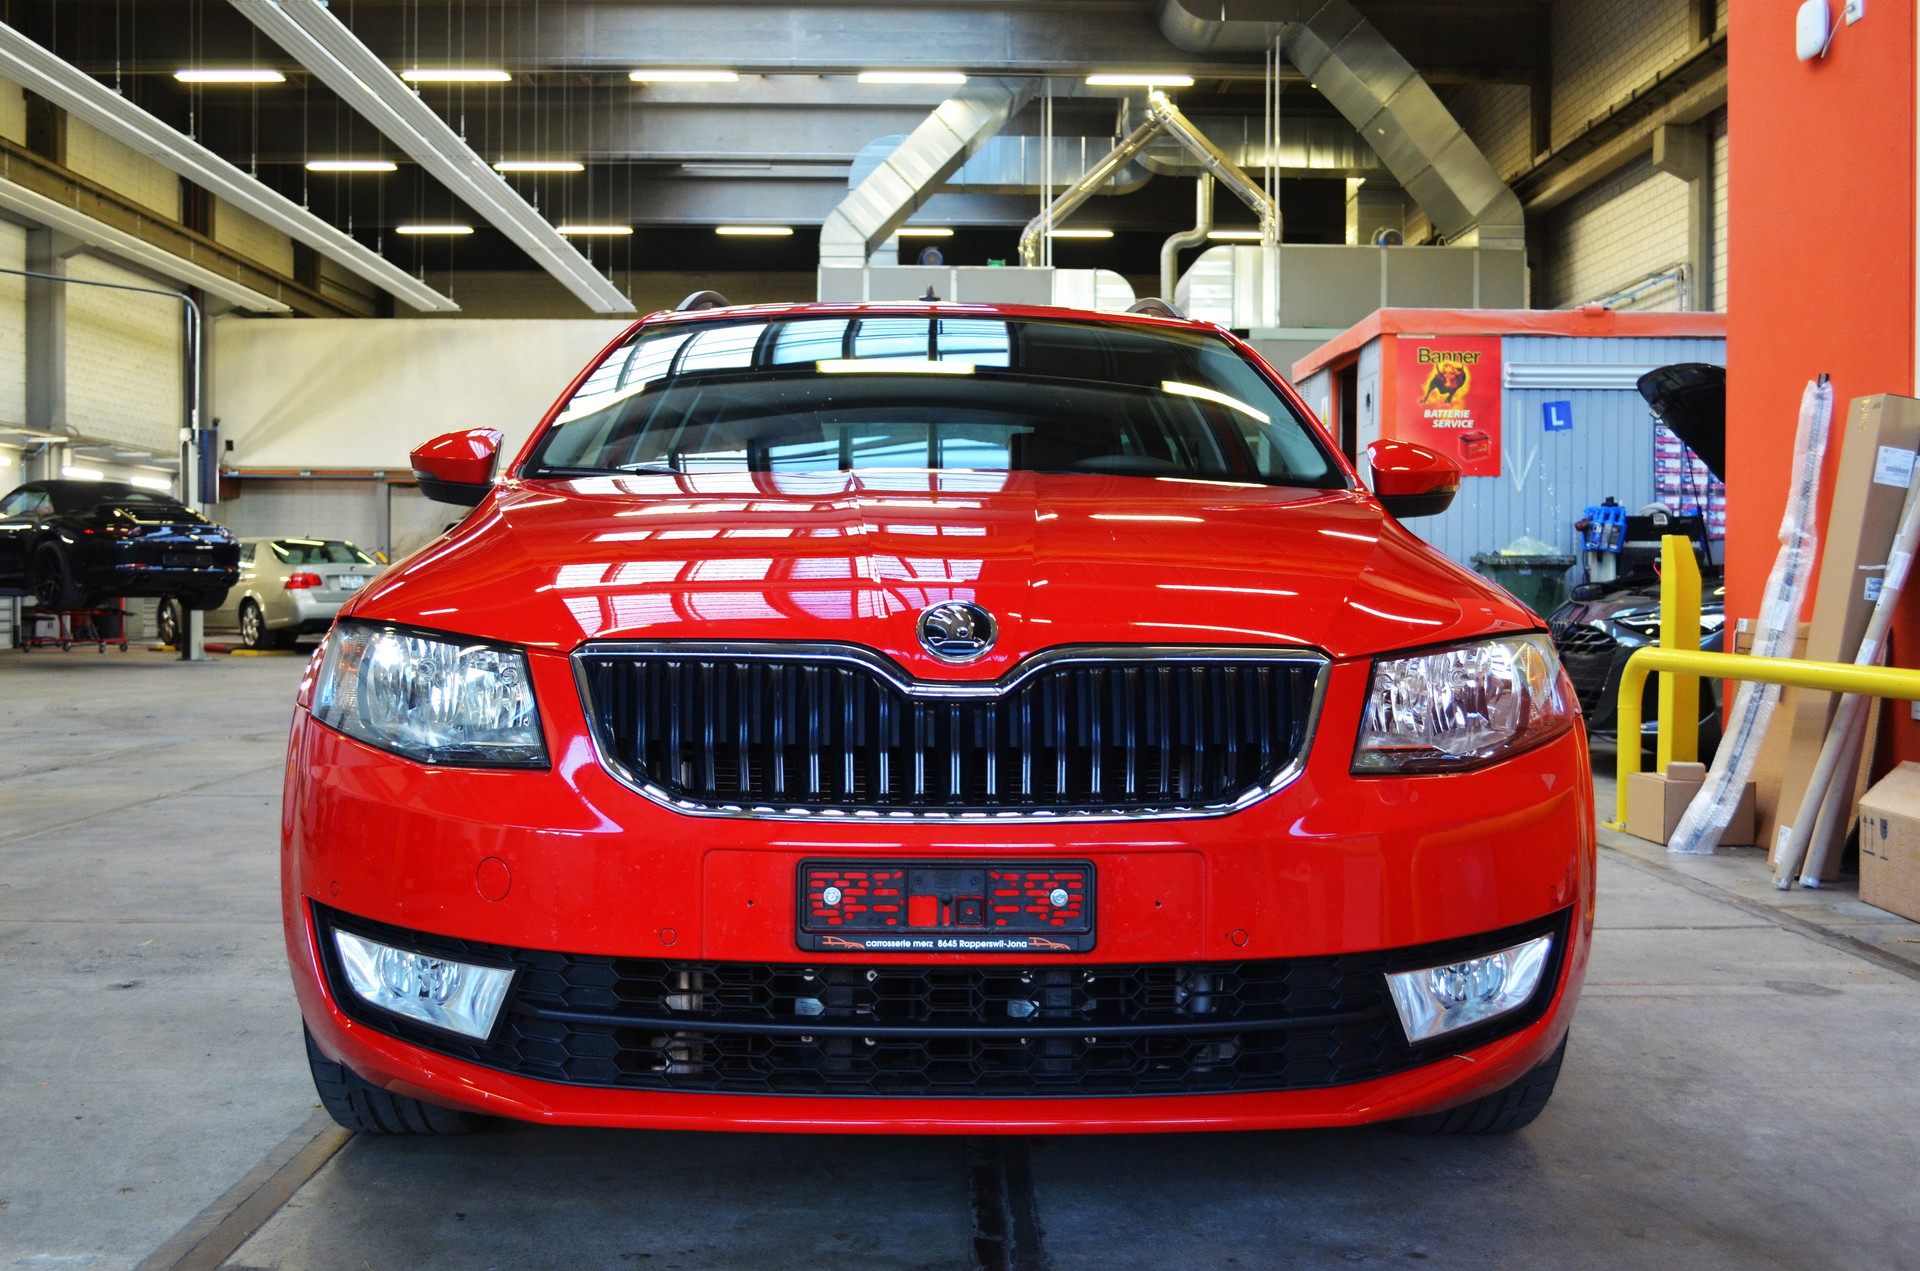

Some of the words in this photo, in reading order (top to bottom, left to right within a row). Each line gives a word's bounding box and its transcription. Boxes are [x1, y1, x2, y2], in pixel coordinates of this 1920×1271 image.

[1418, 348, 1481, 364] Banner
[1423, 409, 1471, 419] BATTERIE
[1551, 406, 1564, 426] L
[1432, 419, 1474, 429] SERVICE
[865, 939, 911, 948] carrosserie
[937, 939, 958, 948] 8645
[959, 939, 1028, 949] Rapperswil-Jona
